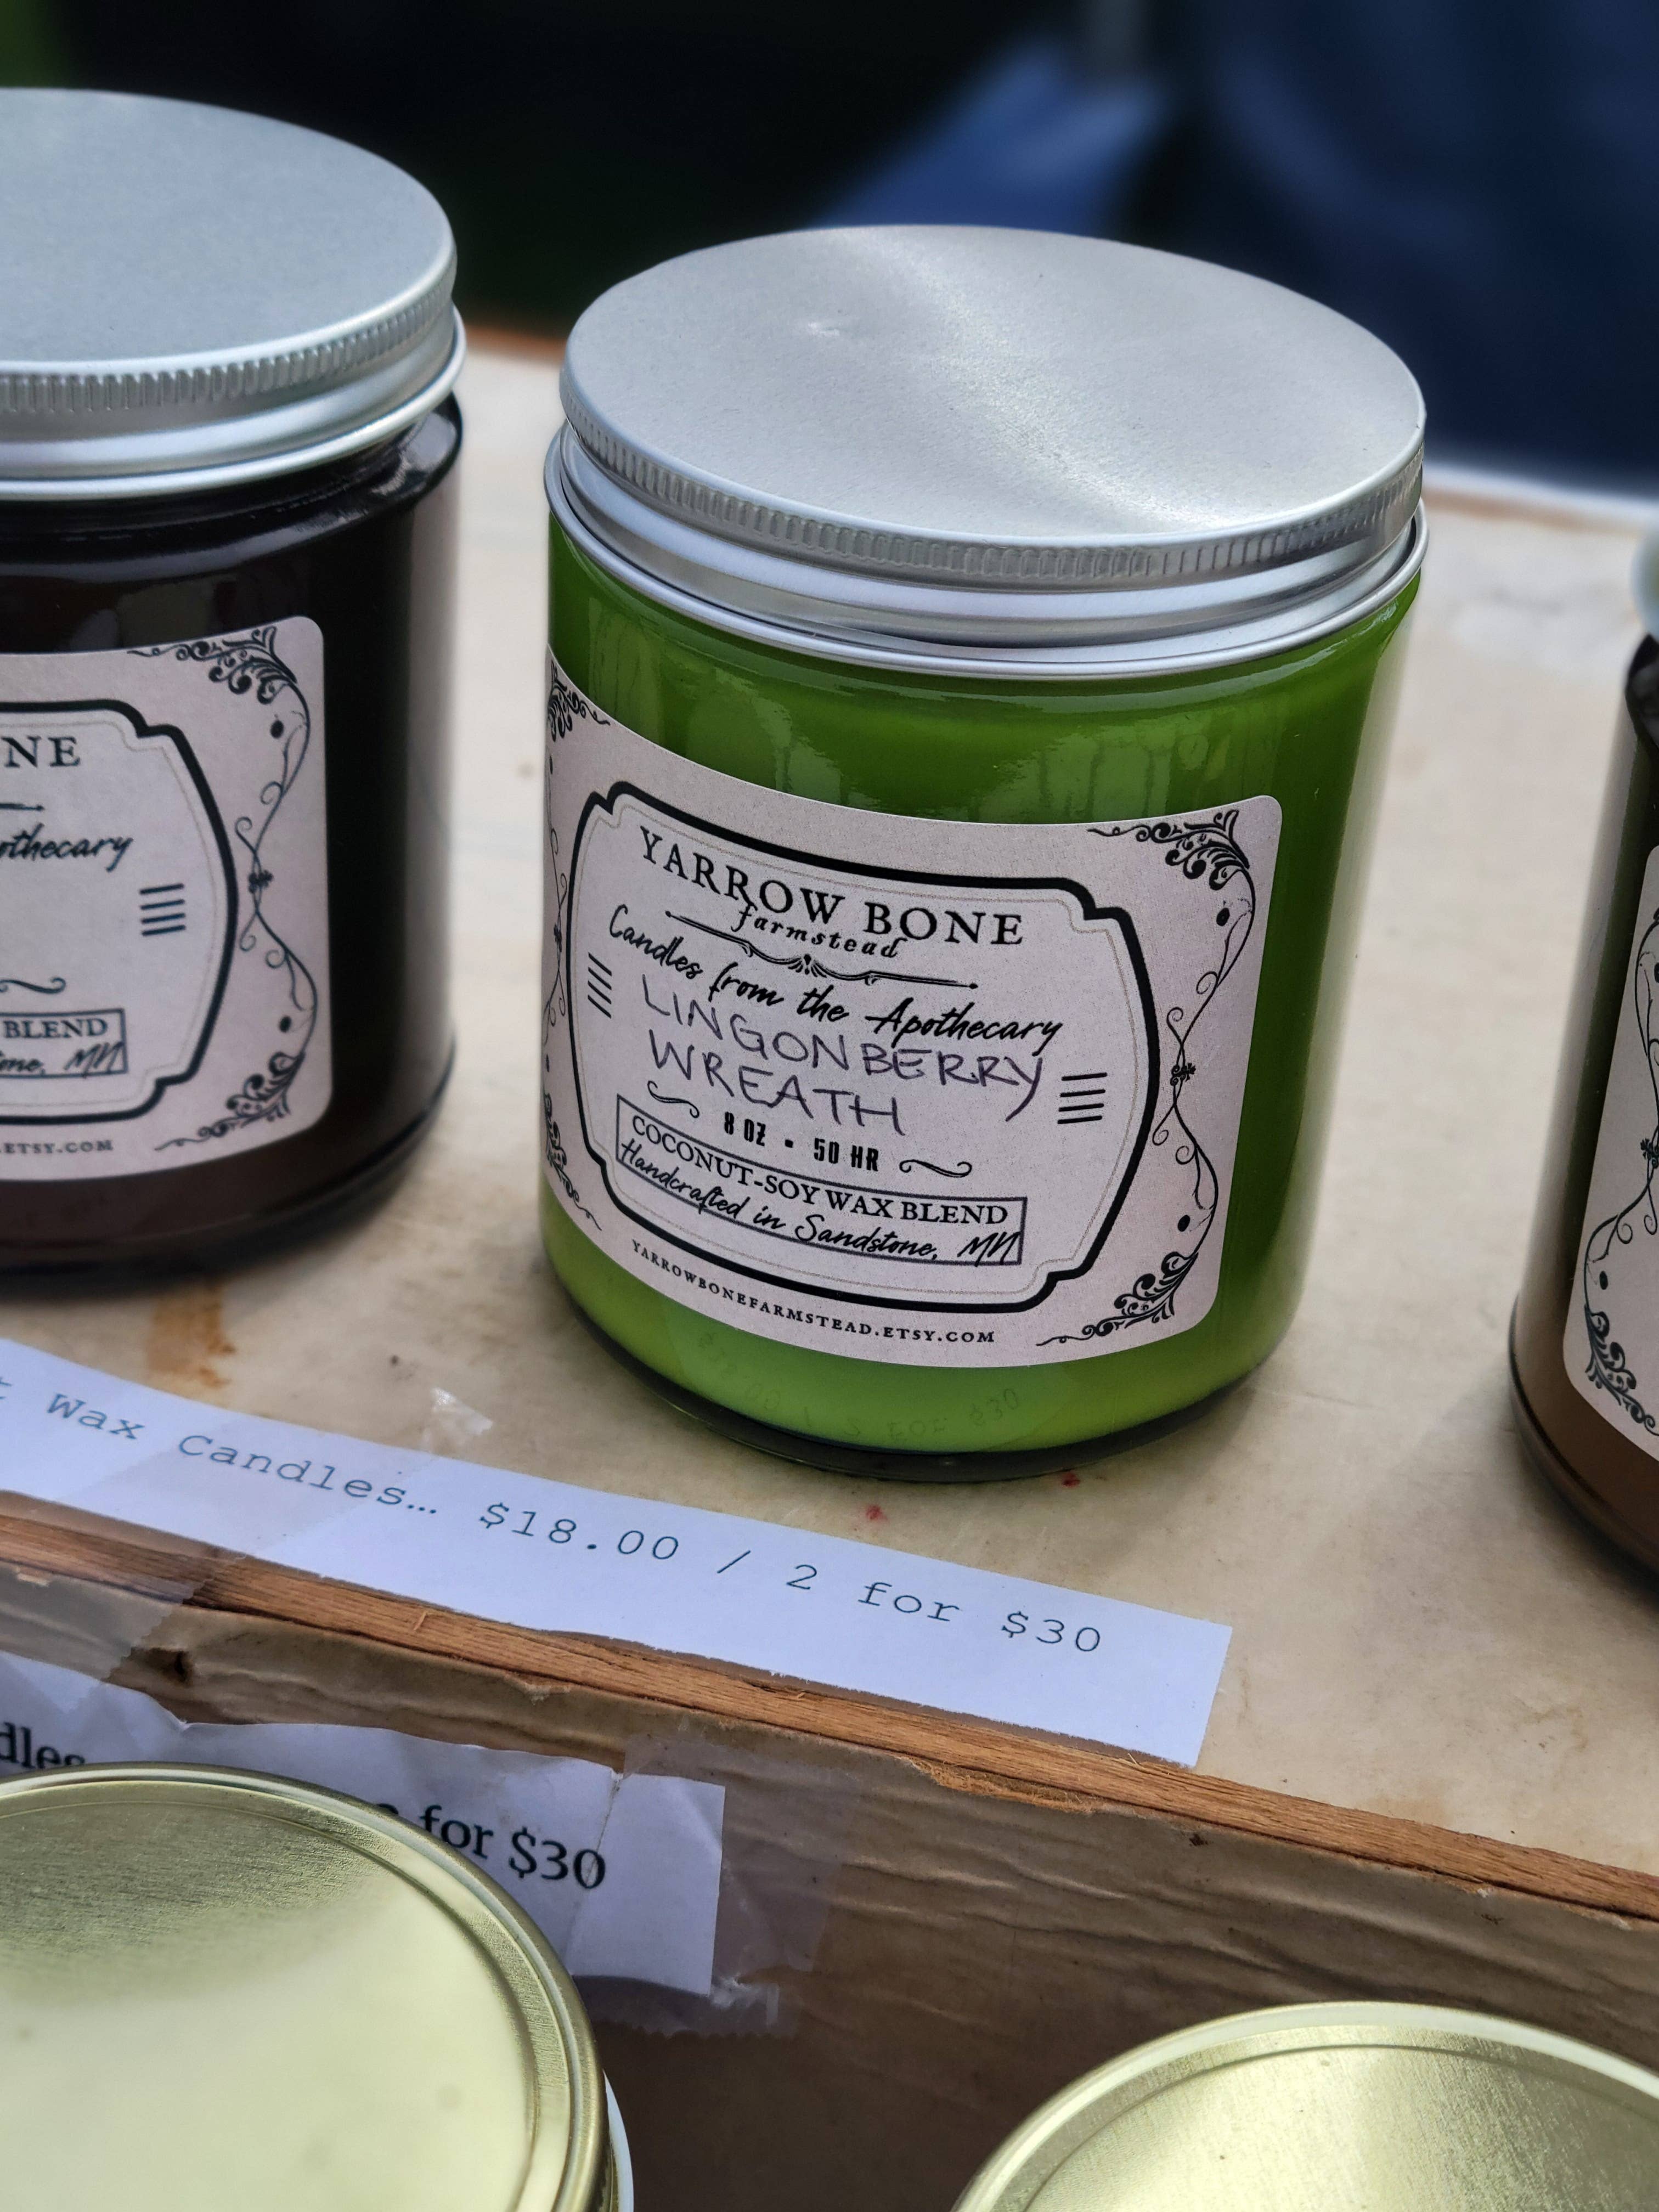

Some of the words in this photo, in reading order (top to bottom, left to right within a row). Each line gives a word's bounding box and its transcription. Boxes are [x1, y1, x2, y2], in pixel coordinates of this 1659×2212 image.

[640, 826, 845, 924] YARROW
[865, 901, 1024, 946] BONE
[731, 904, 907, 960] farmstead
[3, 1018, 109, 1039] BLEND
[609, 904, 703, 980] Candles
[708, 961, 785, 1007] from
[796, 984, 850, 1022] the
[864, 996, 1063, 1057] Apothecary
[64, 1041, 125, 1078] MN
[642, 974, 1043, 1122] LINGONBERRY
[648, 1029, 906, 1136] WREATH
[0, 1139, 114, 1154] ETSY.COM
[632, 1115, 821, 1205] COCONUT-SOY
[825, 1189, 894, 1219] WAX
[900, 1200, 1008, 1224] BLEND
[724, 1111, 735, 1135] 8
[743, 1118, 766, 1147] OZ
[814, 1137, 839, 1164] 50
[850, 1144, 879, 1172] HR
[621, 1138, 751, 1215] Handcrafted
[753, 1205, 786, 1229] in
[794, 1214, 938, 1260] Sandstone,
[956, 1231, 1021, 1268] MN
[631, 1239, 995, 1344] YARROWBONEFARMSTEAD.ETSY.COM
[47, 1392, 145, 1440] Wax
[478, 1502, 679, 1560] $18.00
[716, 1549, 752, 1574] /
[786, 1564, 817, 1590] 2
[857, 1581, 960, 1622] for
[1001, 1610, 1101, 1652] $30
[419, 1804, 494, 1860] for
[509, 1826, 607, 1890] $30
